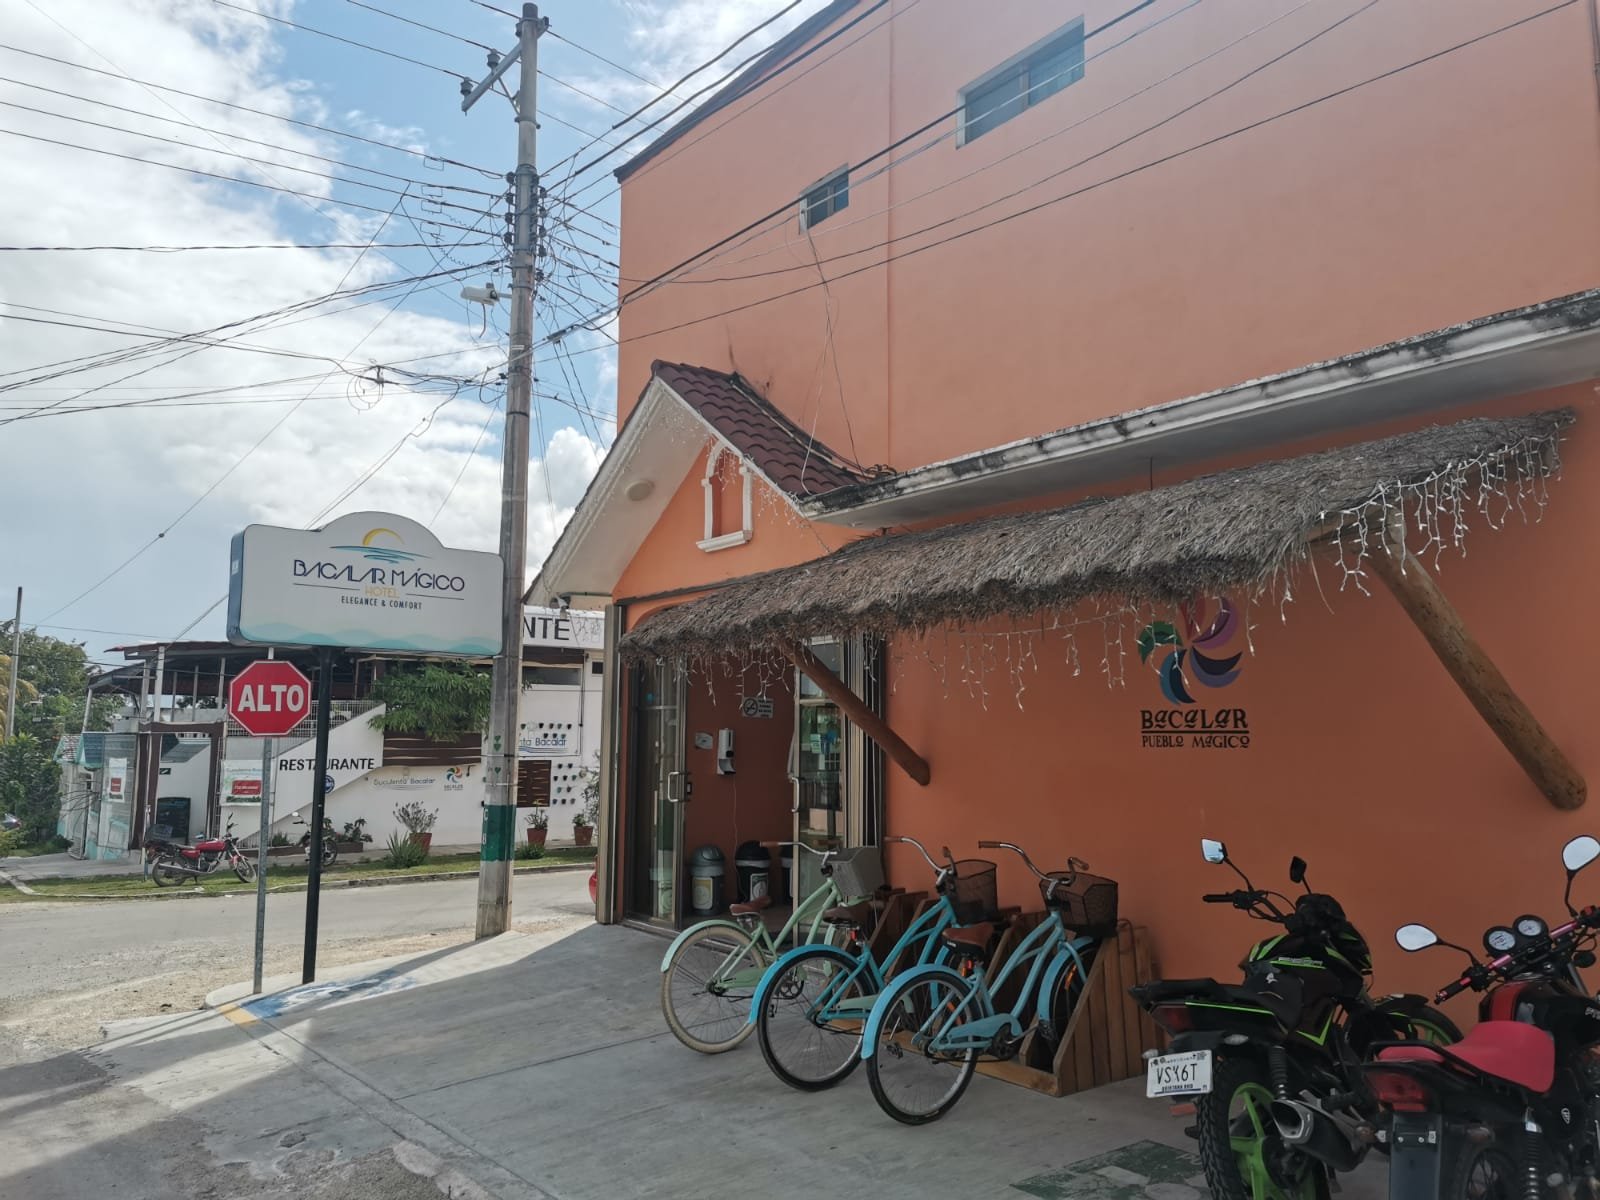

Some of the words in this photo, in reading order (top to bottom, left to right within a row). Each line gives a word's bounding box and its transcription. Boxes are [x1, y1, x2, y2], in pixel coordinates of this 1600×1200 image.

[293, 559, 385, 585] BACALAR
[391, 568, 465, 592] MÁGICO
[341, 595, 378, 607] ELEGANCE
[381, 599, 386, 607] &
[389, 600, 423, 610] COMFORT
[365, 586, 399, 598] HOTEL
[237, 684, 305, 712] ALTO
